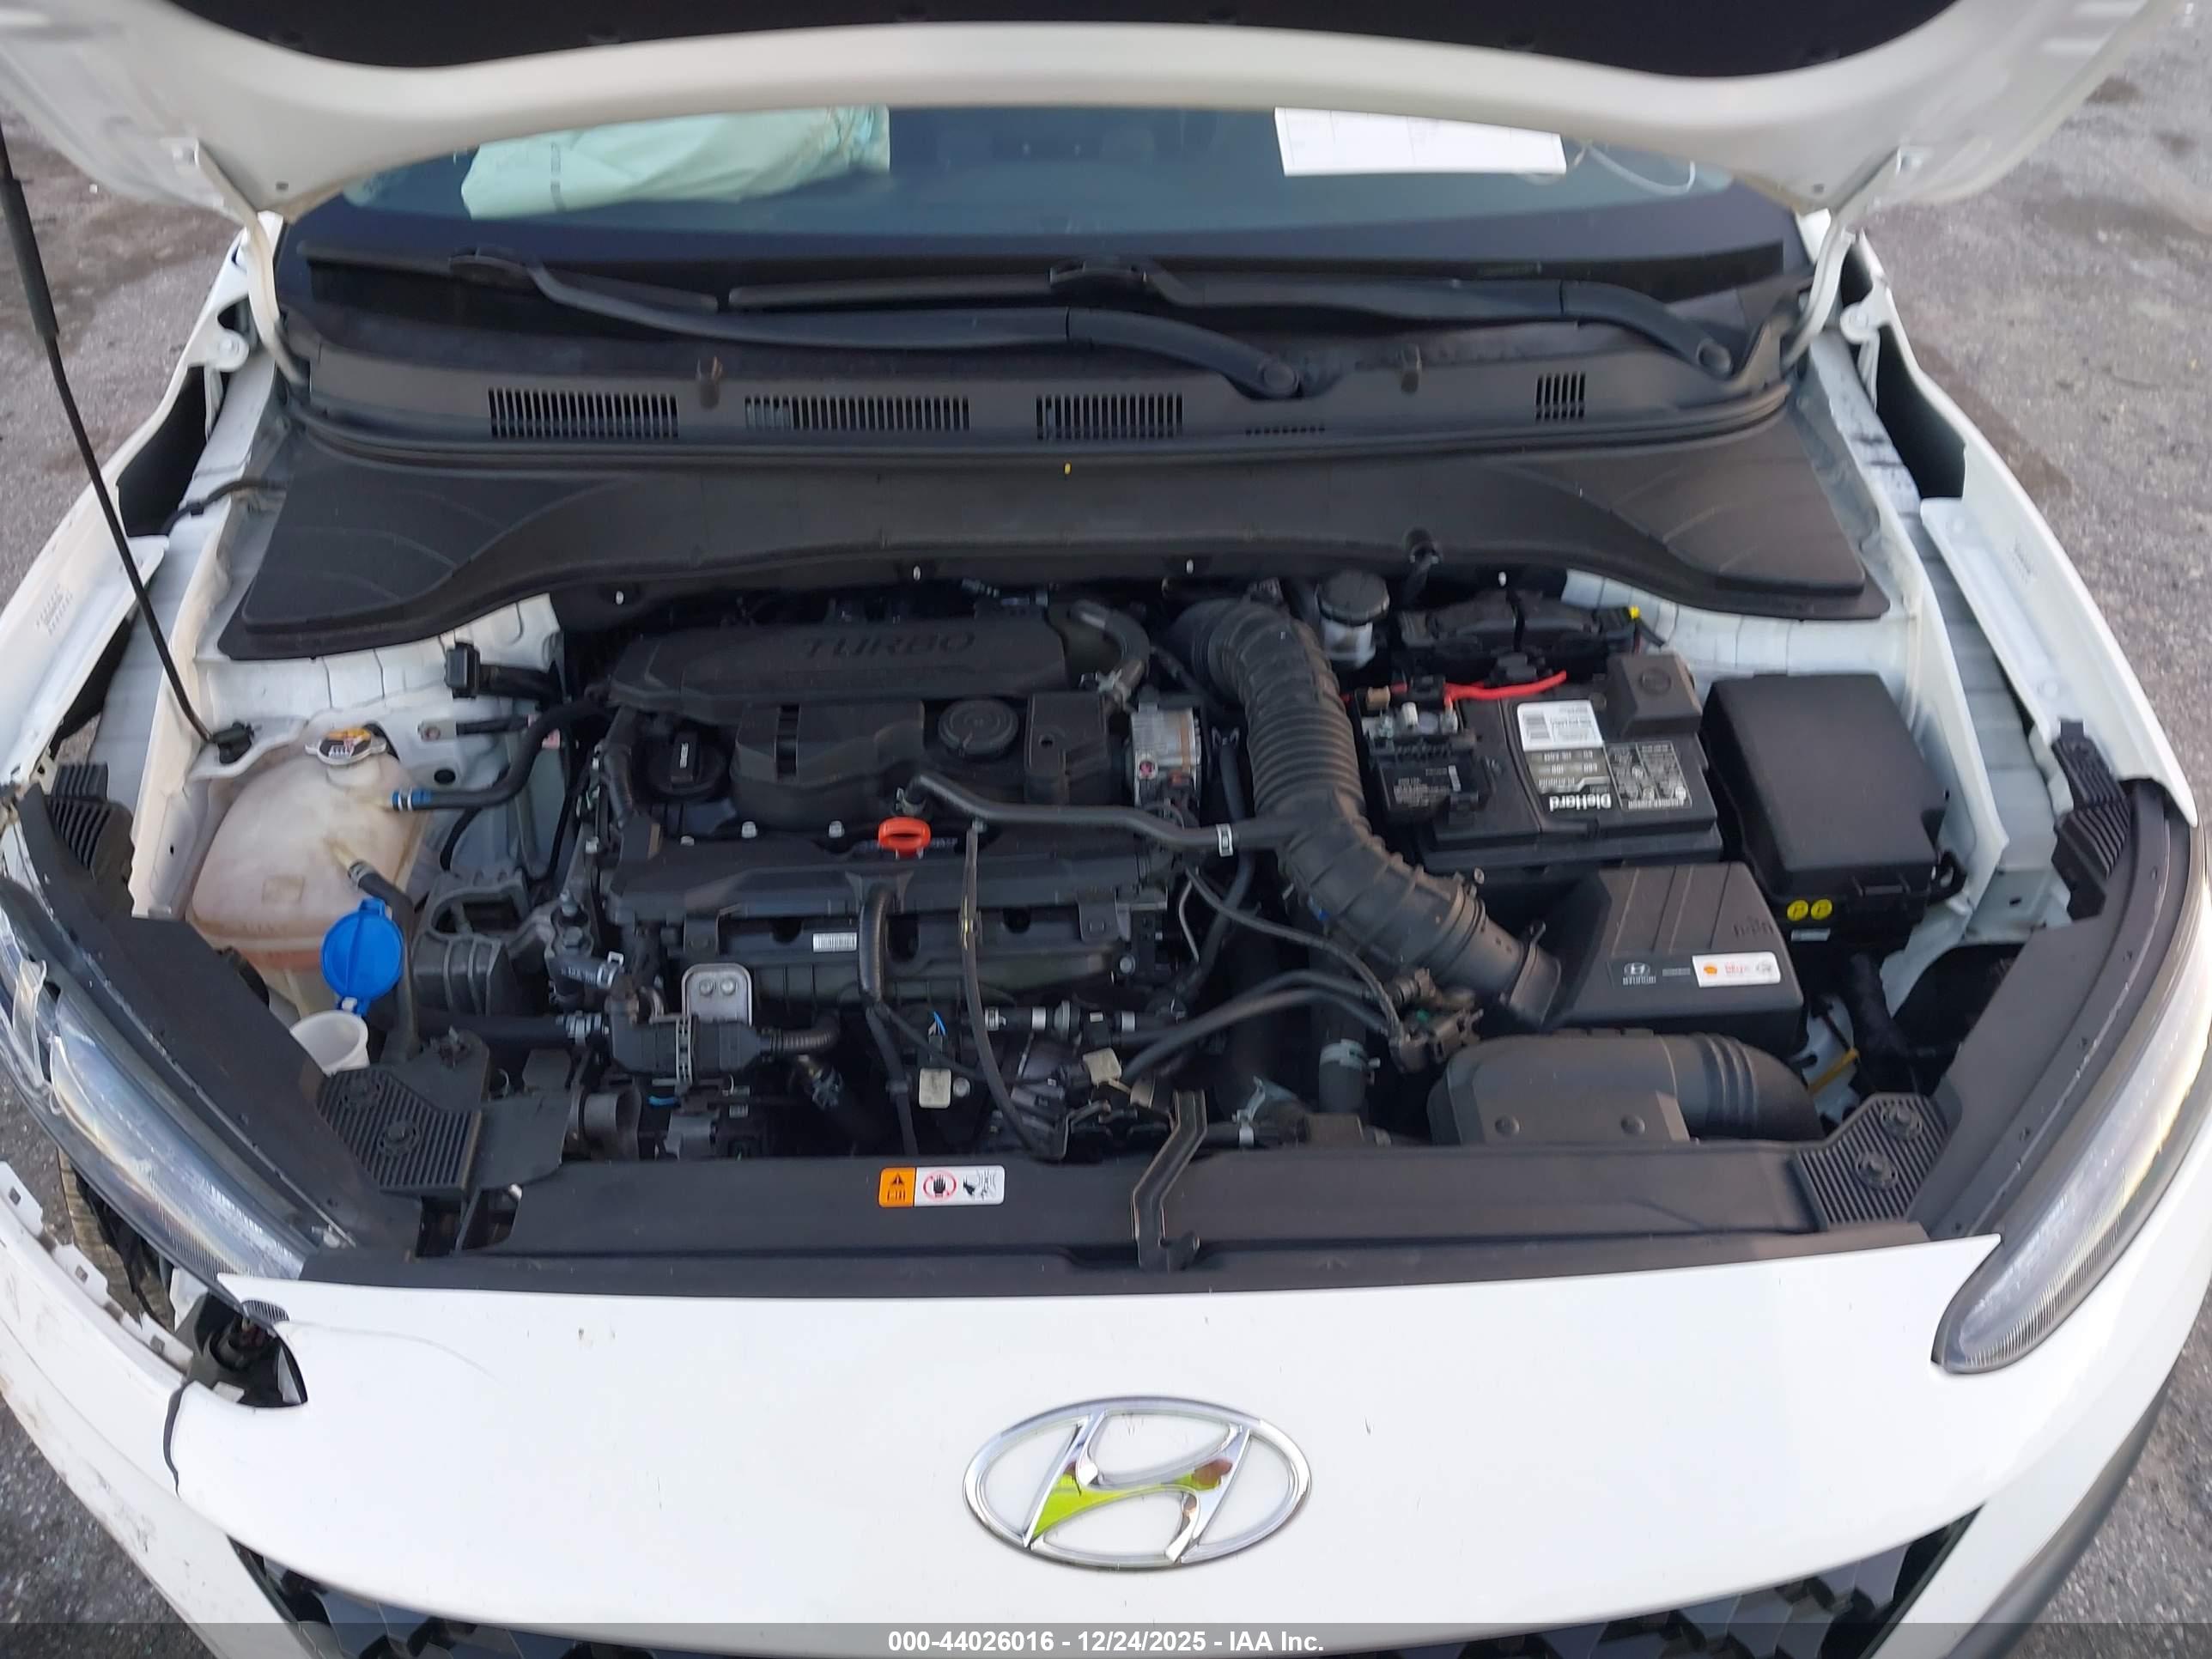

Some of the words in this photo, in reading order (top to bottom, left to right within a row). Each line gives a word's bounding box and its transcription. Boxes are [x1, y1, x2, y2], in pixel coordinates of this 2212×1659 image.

[804, 632, 975, 658] TURBO
[1549, 793, 1612, 811] DieHard
[1622, 975, 1656, 986] HYUNDAI
